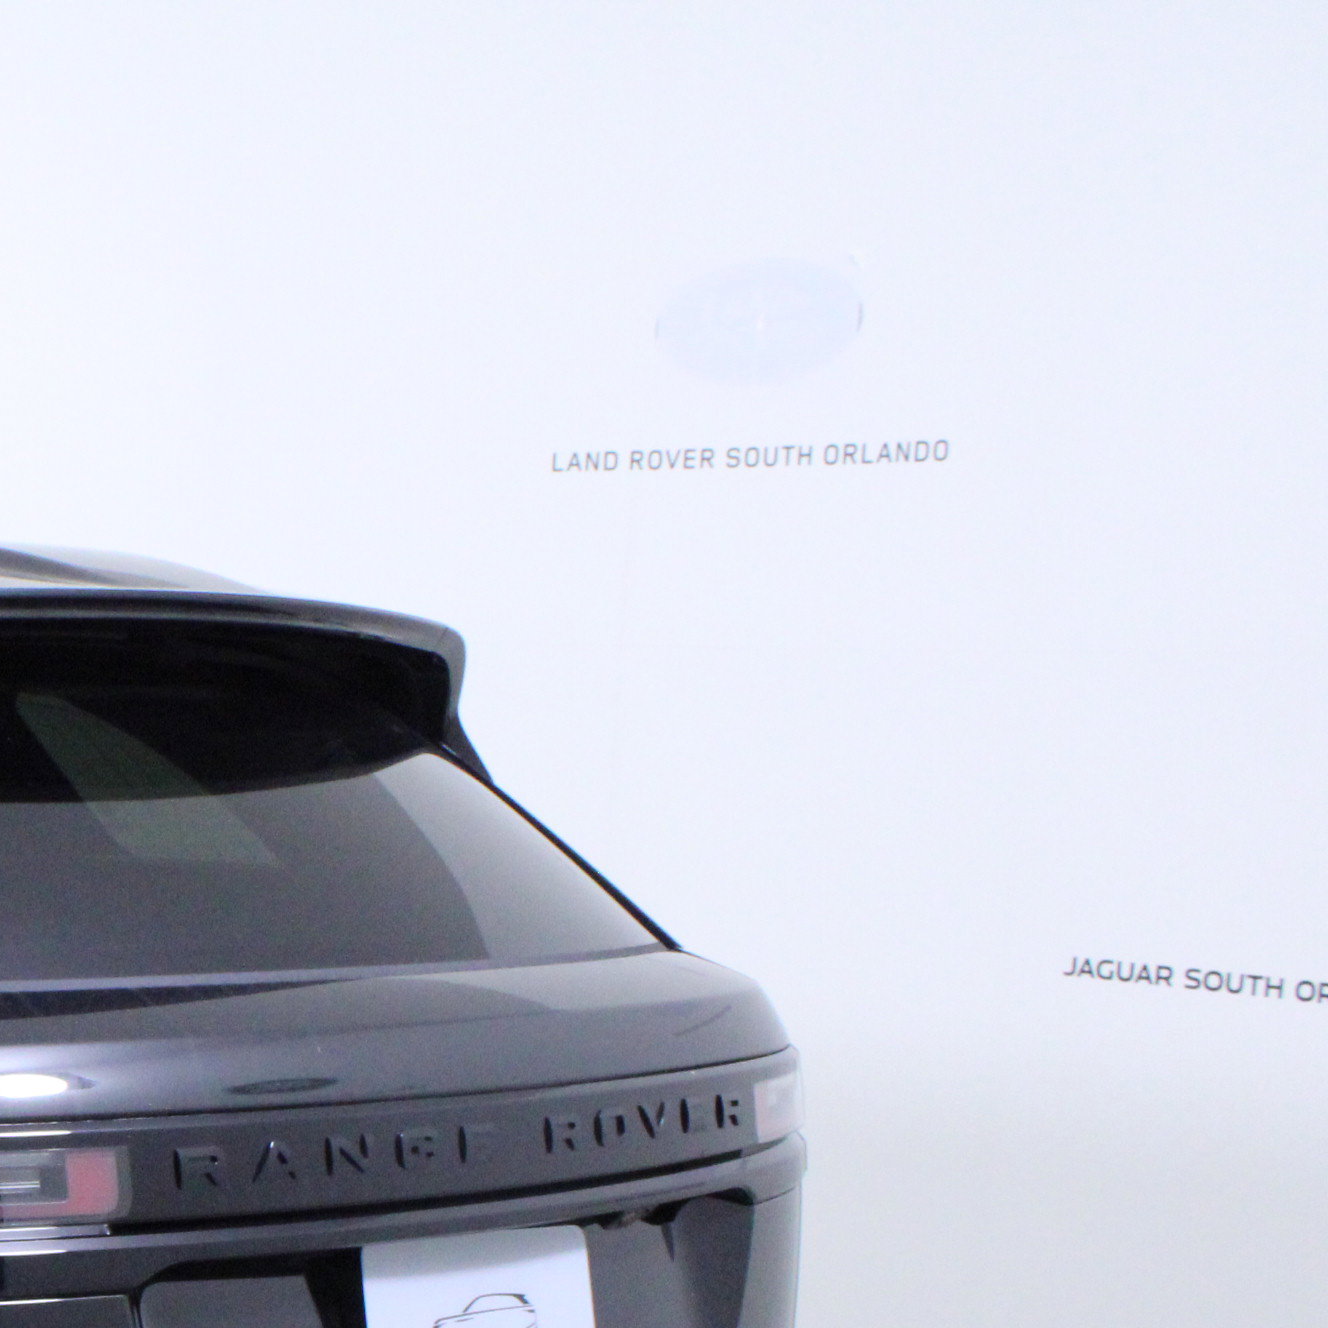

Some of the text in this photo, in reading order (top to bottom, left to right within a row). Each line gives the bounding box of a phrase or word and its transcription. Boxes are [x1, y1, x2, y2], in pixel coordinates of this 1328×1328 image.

[551, 438, 950, 473] LAND ROVER SOUTH ORLANDO
[1062, 956, 1175, 988] JAGUAR
[1184, 967, 1285, 1000] SOUTH
[172, 1092, 742, 1191] RANGE ROVER
